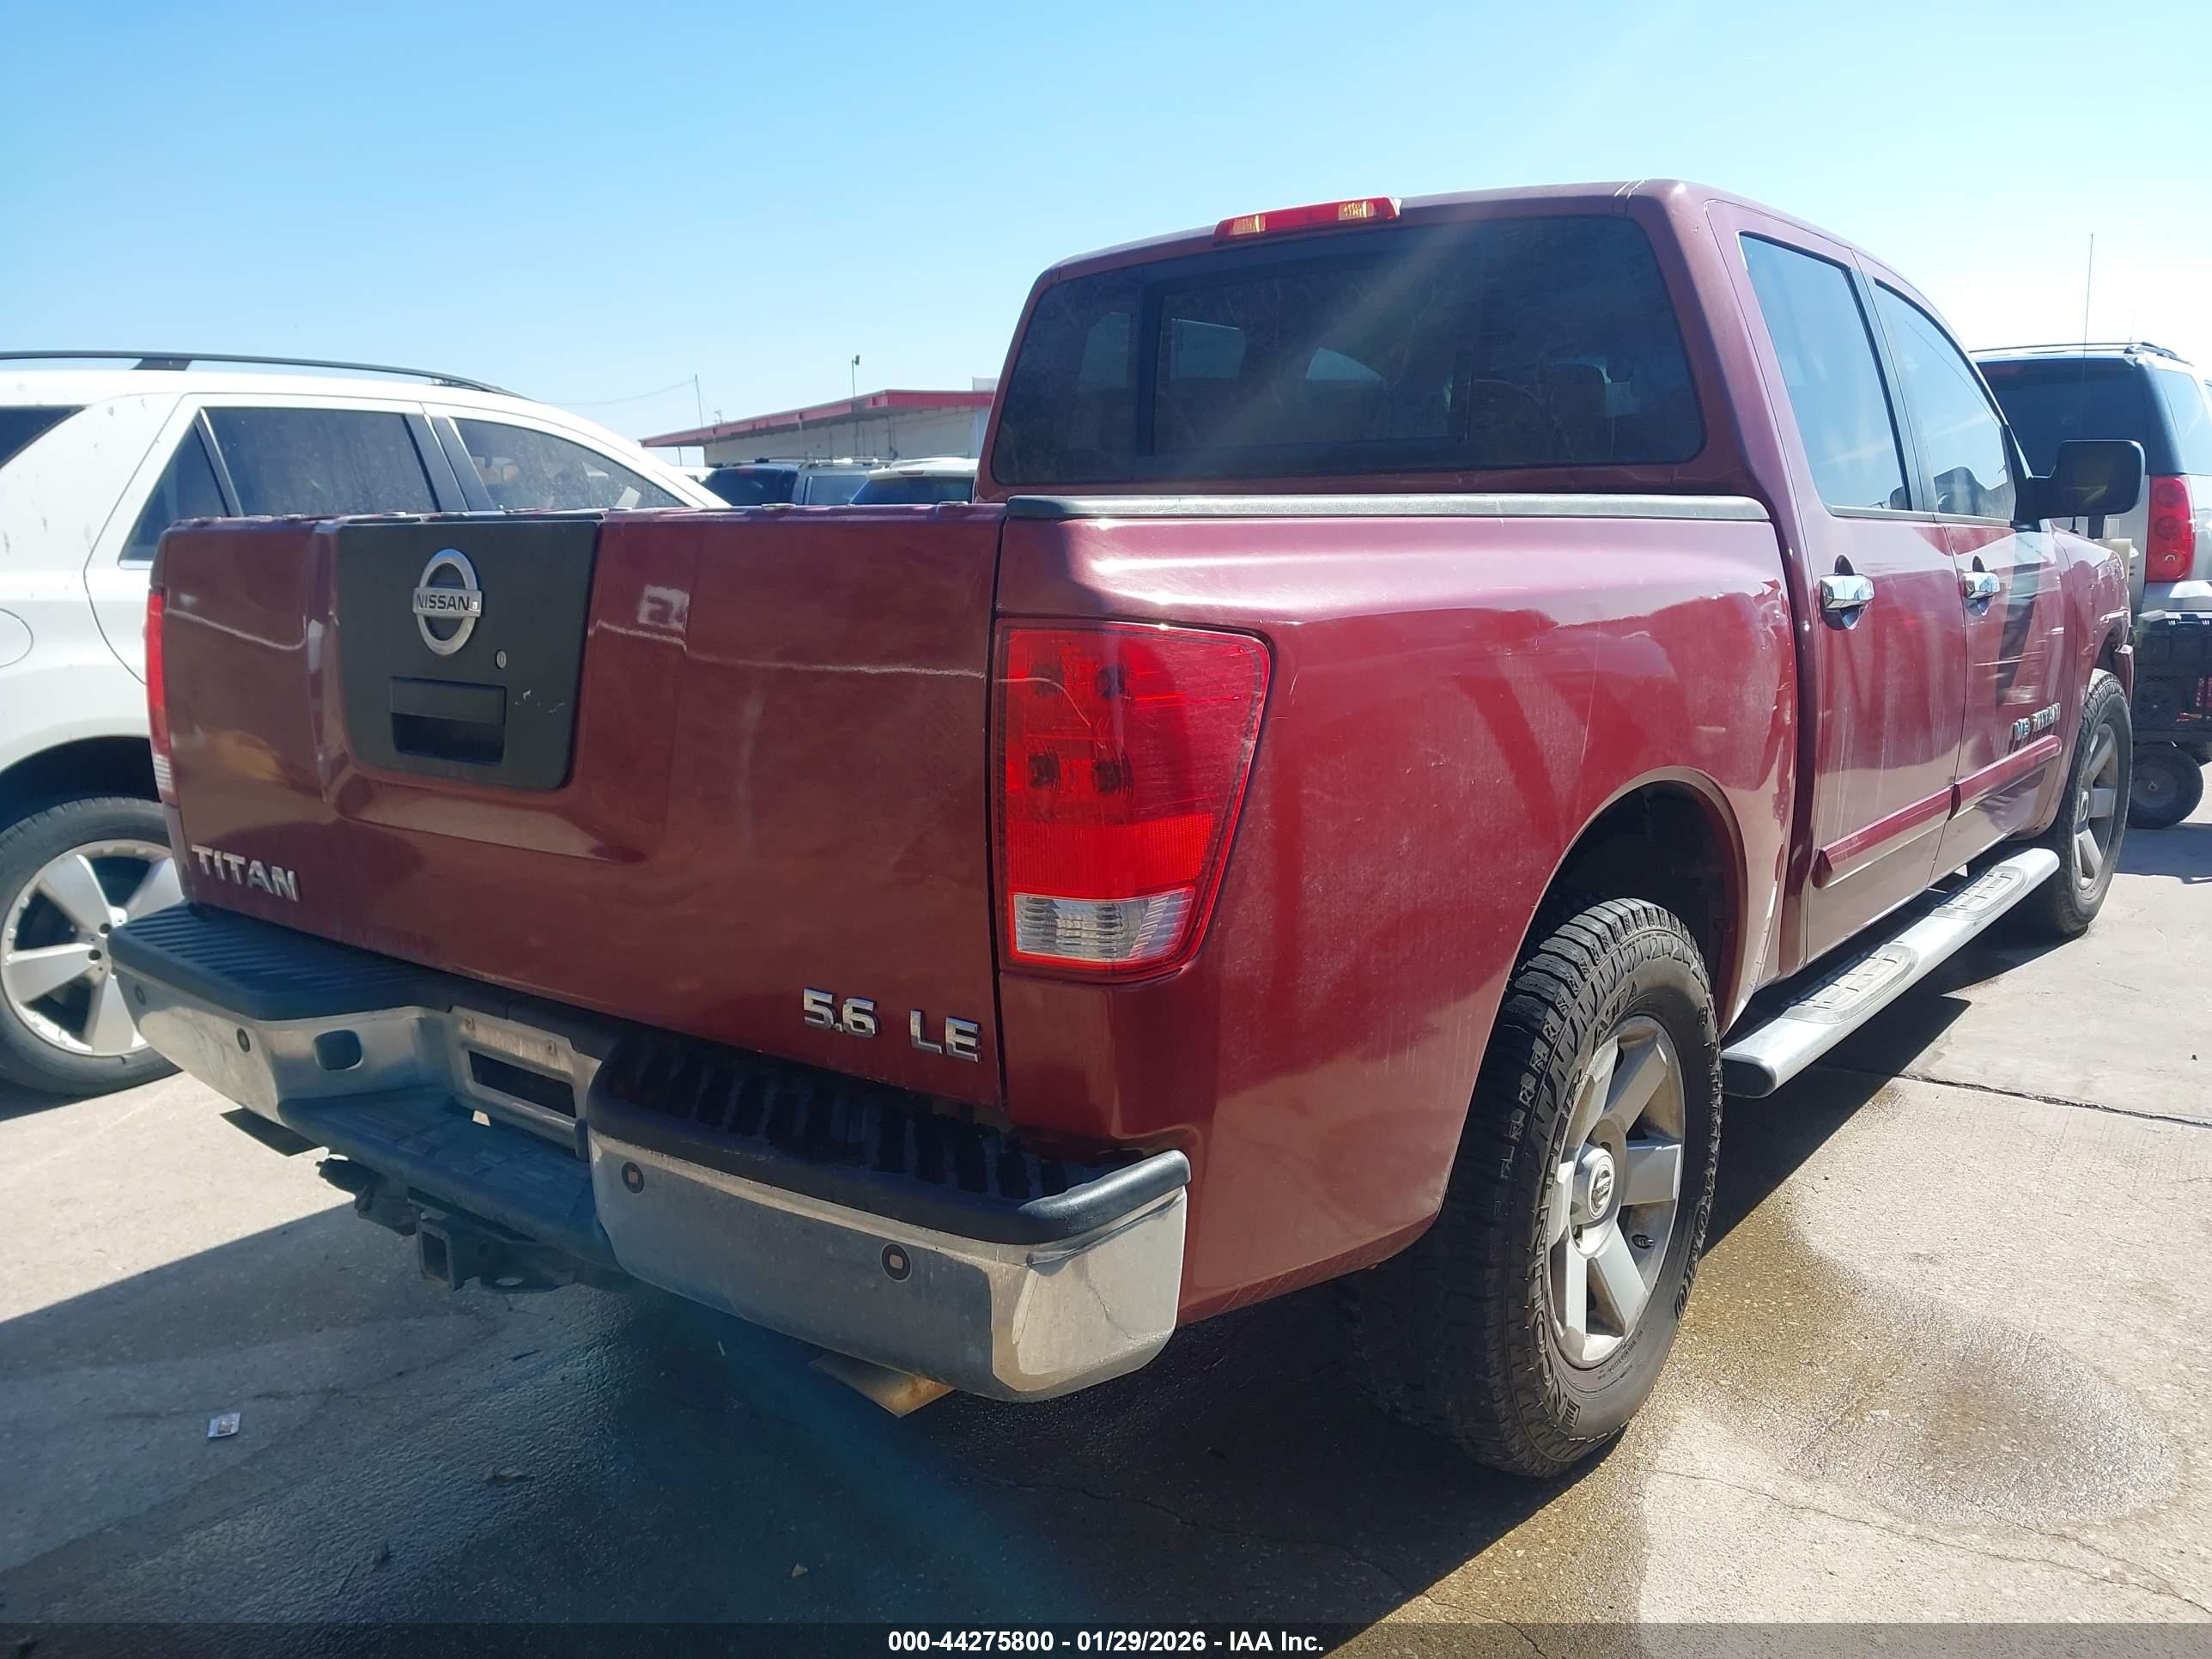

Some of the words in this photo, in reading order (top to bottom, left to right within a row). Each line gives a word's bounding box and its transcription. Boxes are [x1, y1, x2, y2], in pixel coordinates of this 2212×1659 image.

[416, 593, 471, 611] NISSAN
[191, 843, 301, 902] TITAN
[803, 988, 878, 1038] 5.6
[909, 1007, 981, 1064] LE
